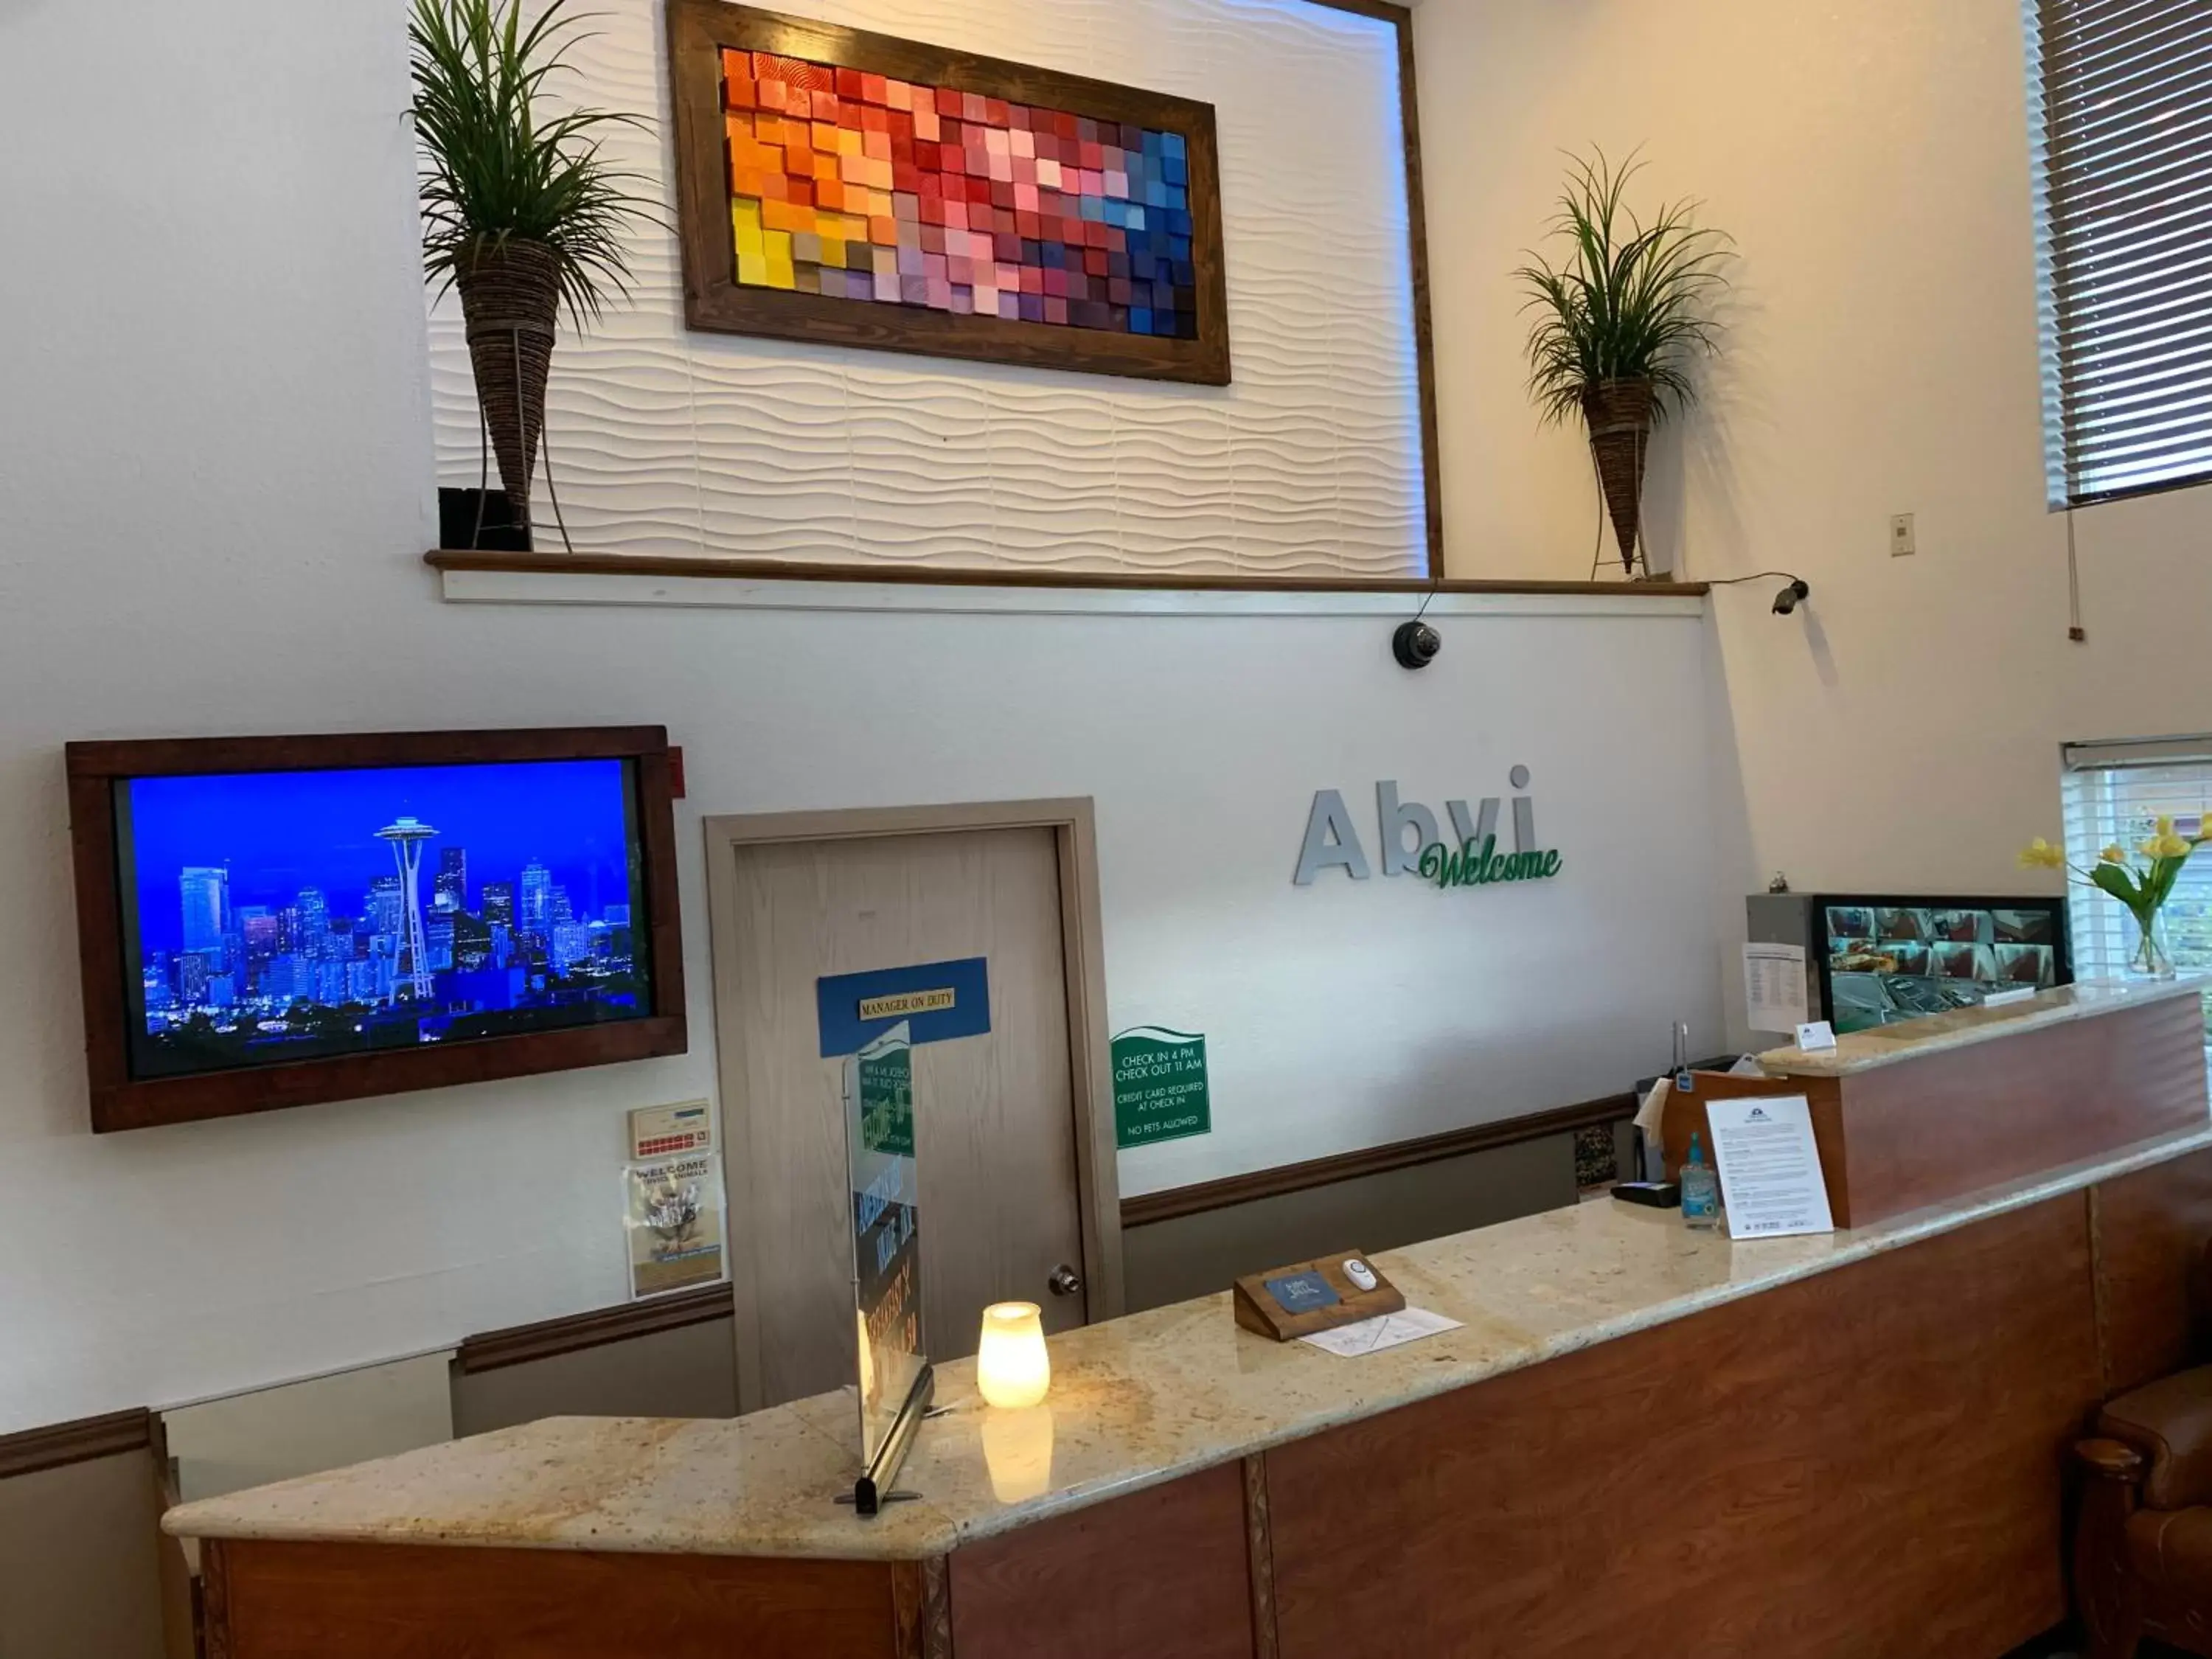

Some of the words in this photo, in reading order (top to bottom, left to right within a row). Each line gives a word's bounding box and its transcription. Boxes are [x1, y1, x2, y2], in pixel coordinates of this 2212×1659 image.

[1419, 834, 1562, 888] Welcome
[862, 999, 908, 1015] MANAGER
[911, 996, 924, 1009] ON
[928, 993, 951, 1006] DUTY
[1122, 1053, 1154, 1068] CHECK
[1157, 1051, 1169, 1062] IN
[1172, 1050, 1178, 1060] 4
[1180, 1047, 1194, 1059] PM
[1116, 1068, 1148, 1082] CHECK
[1151, 1063, 1171, 1076] OUT
[1175, 1061, 1183, 1071] 11
[1186, 1059, 1202, 1070] AM
[1117, 1091, 1142, 1104] CREDIT
[1145, 1088, 1166, 1099] CARD
[1168, 1082, 1203, 1095] REQUIRED
[1138, 1101, 1147, 1112] AT
[1150, 1097, 1175, 1110] CHECK
[1176, 1094, 1186, 1105] IN
[1127, 1126, 1142, 1135] NO
[1144, 1121, 1161, 1133] PETS
[1162, 1116, 1198, 1130] ALLOWED
[636, 1159, 707, 1179] WELCOME
